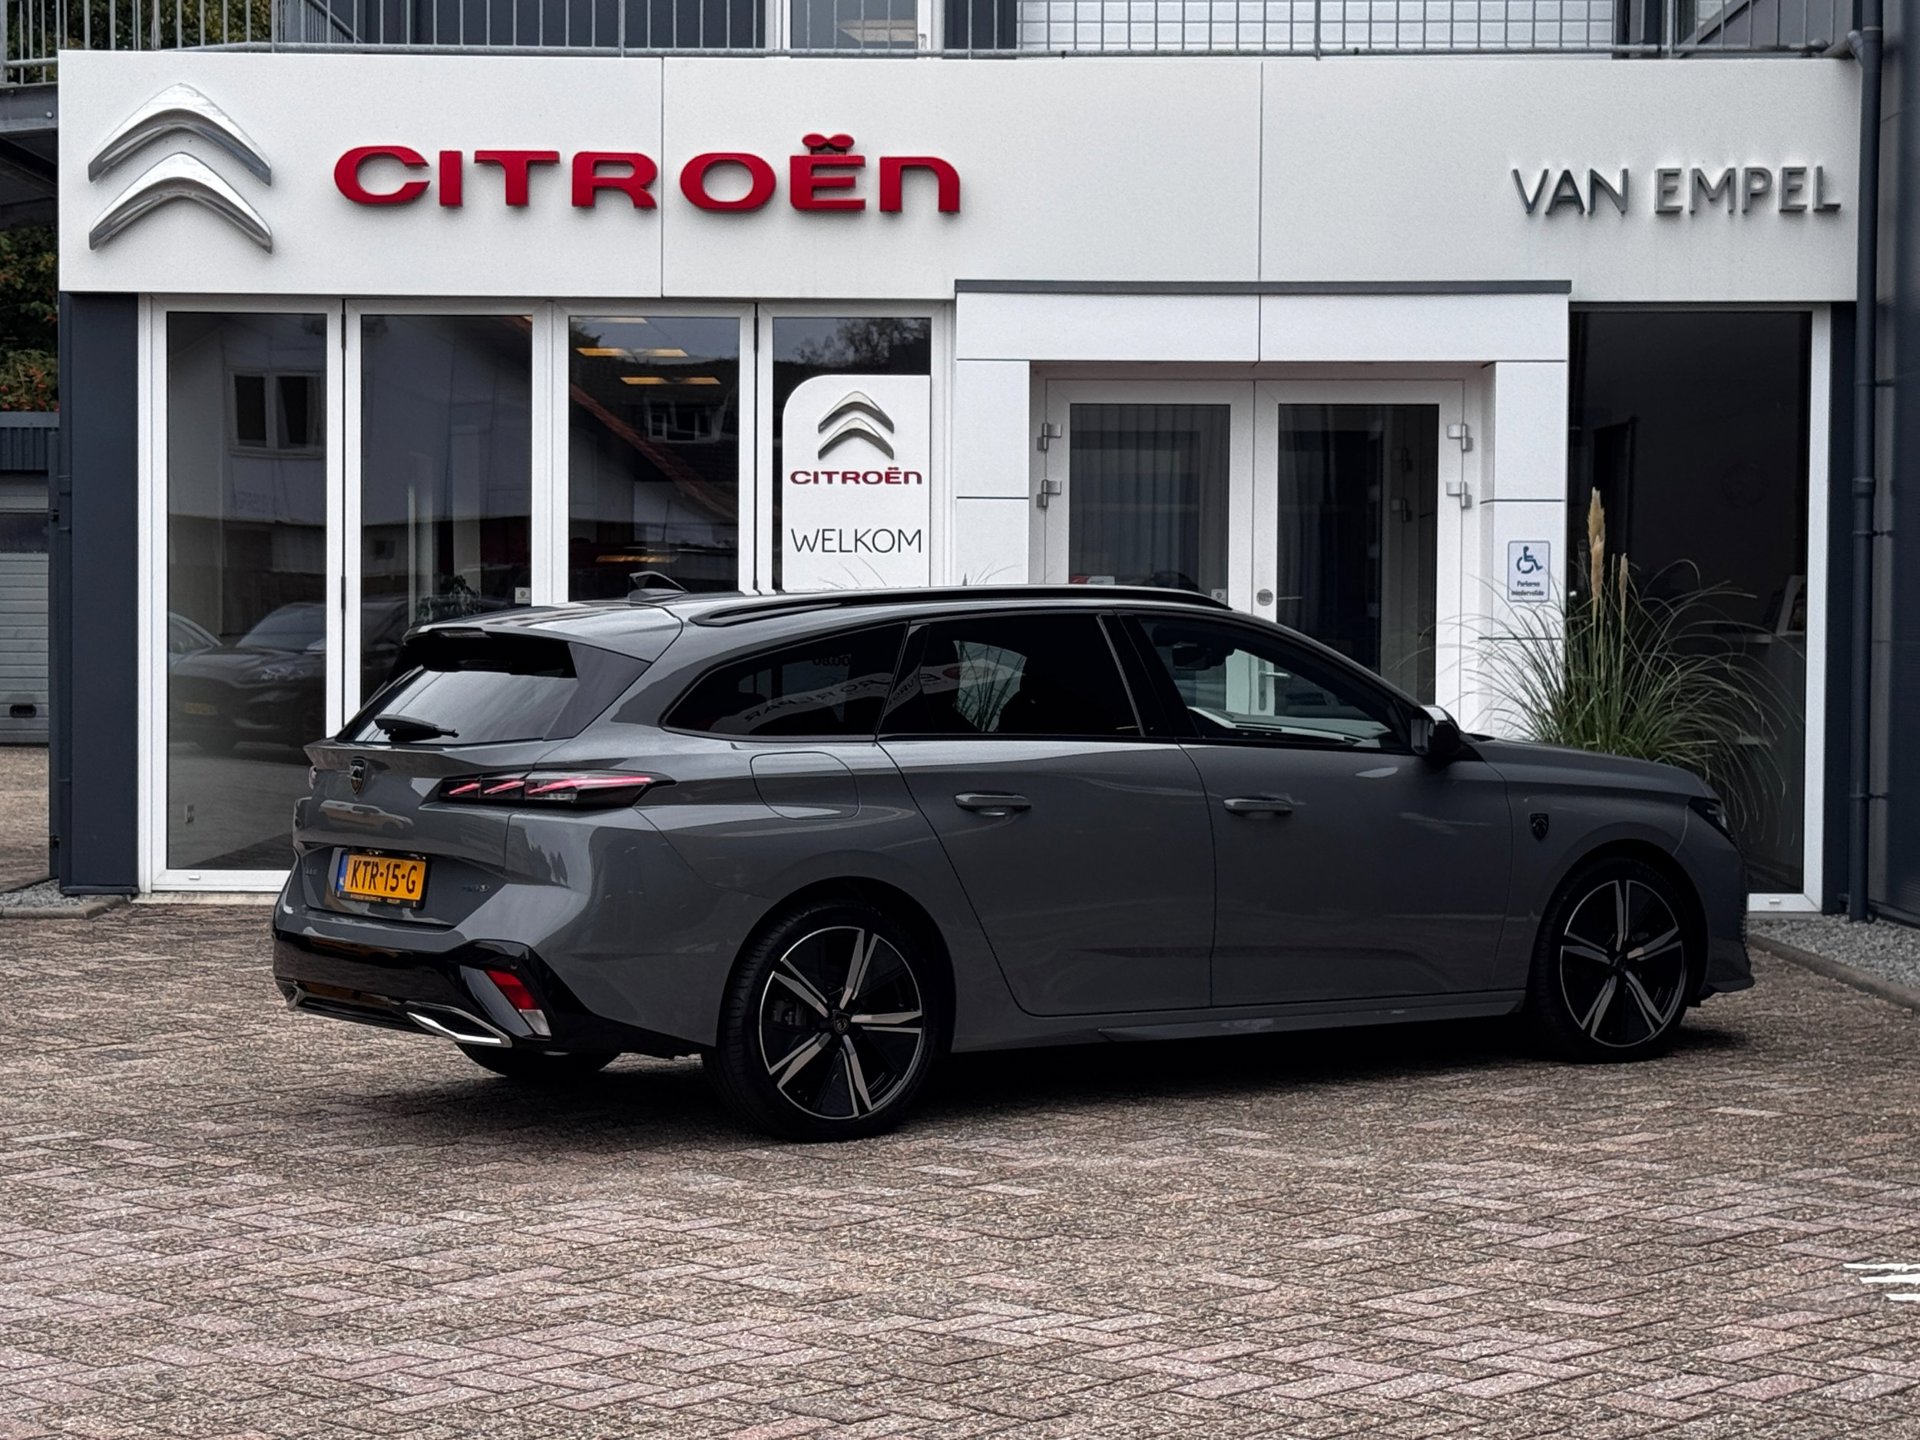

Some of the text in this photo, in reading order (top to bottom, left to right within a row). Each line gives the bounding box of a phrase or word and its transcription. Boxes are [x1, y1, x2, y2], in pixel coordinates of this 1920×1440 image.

[1510, 165, 1842, 217] VAN EMPEL
[790, 528, 922, 553] WELKOM
[350, 860, 418, 895] KTR-15-G
